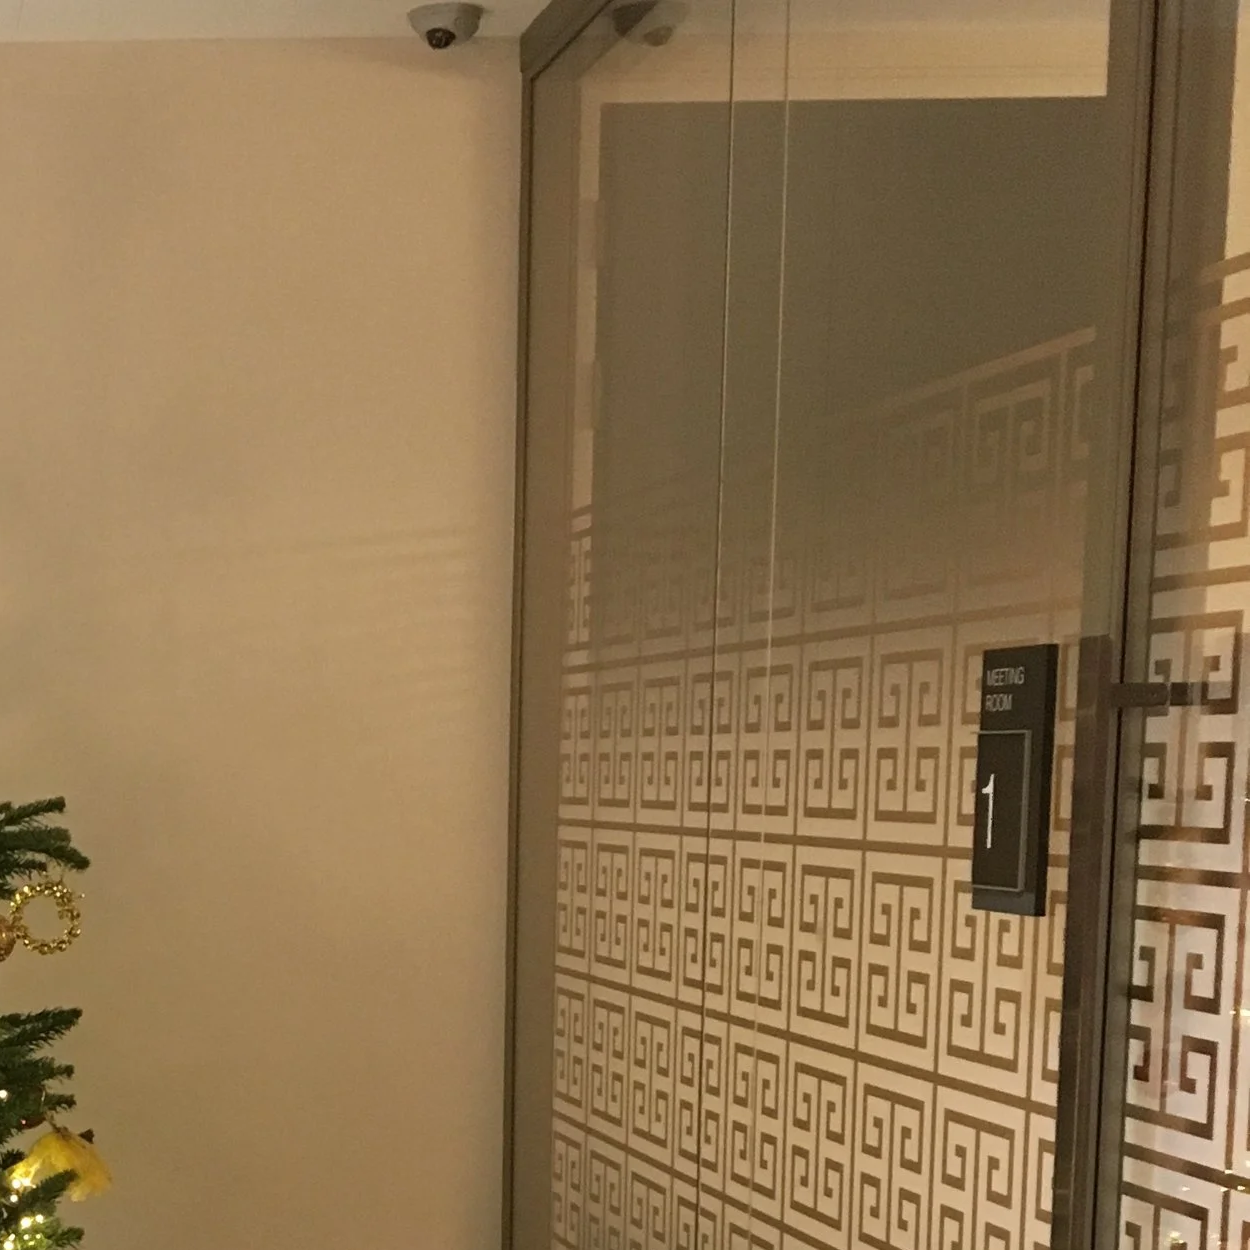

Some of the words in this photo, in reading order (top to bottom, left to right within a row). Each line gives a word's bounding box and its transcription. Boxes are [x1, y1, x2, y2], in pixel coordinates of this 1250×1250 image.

[986, 666, 1025, 686] MEETING
[985, 694, 1012, 712] ROOM
[981, 773, 995, 849] 1
